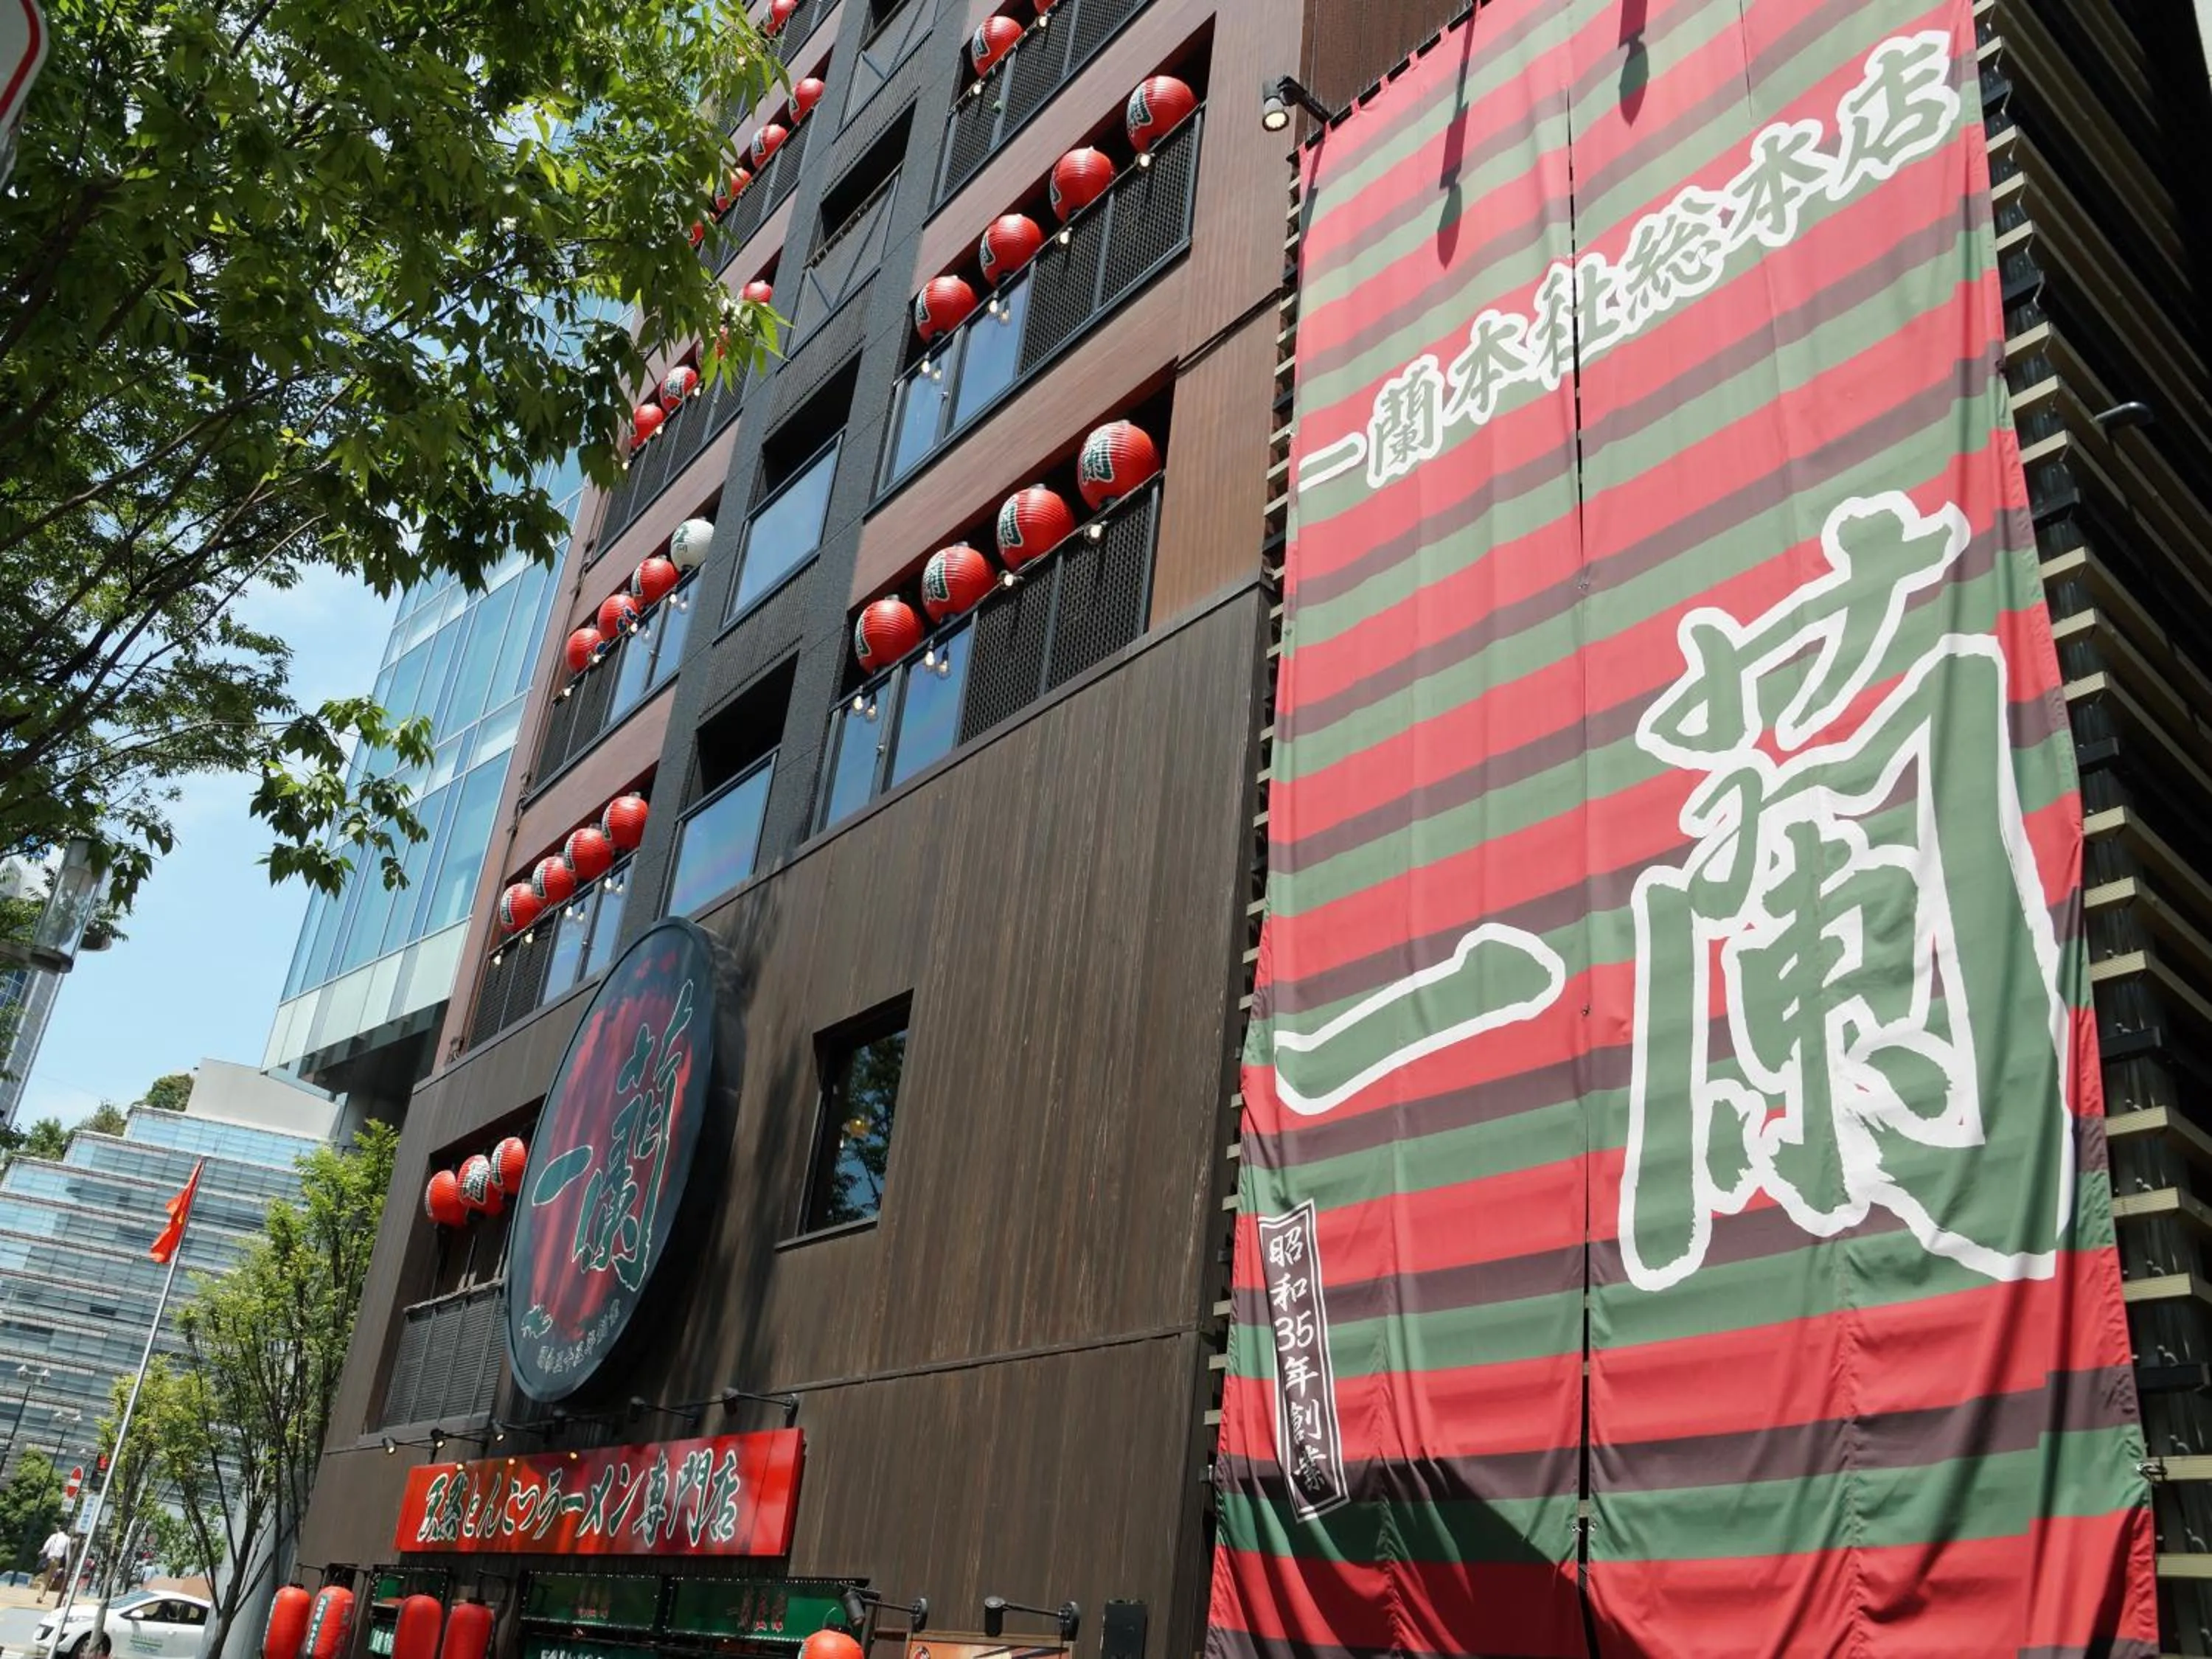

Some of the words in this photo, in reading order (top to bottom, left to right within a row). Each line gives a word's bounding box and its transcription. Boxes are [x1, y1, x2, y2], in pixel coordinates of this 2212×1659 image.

[1298, 30, 1960, 492] 一蘭本社総本店
[1275, 490, 2074, 1292] 一蘭
[532, 979, 694, 1292] 一蘭
[1268, 1225, 1329, 1492] 昭和35年創業
